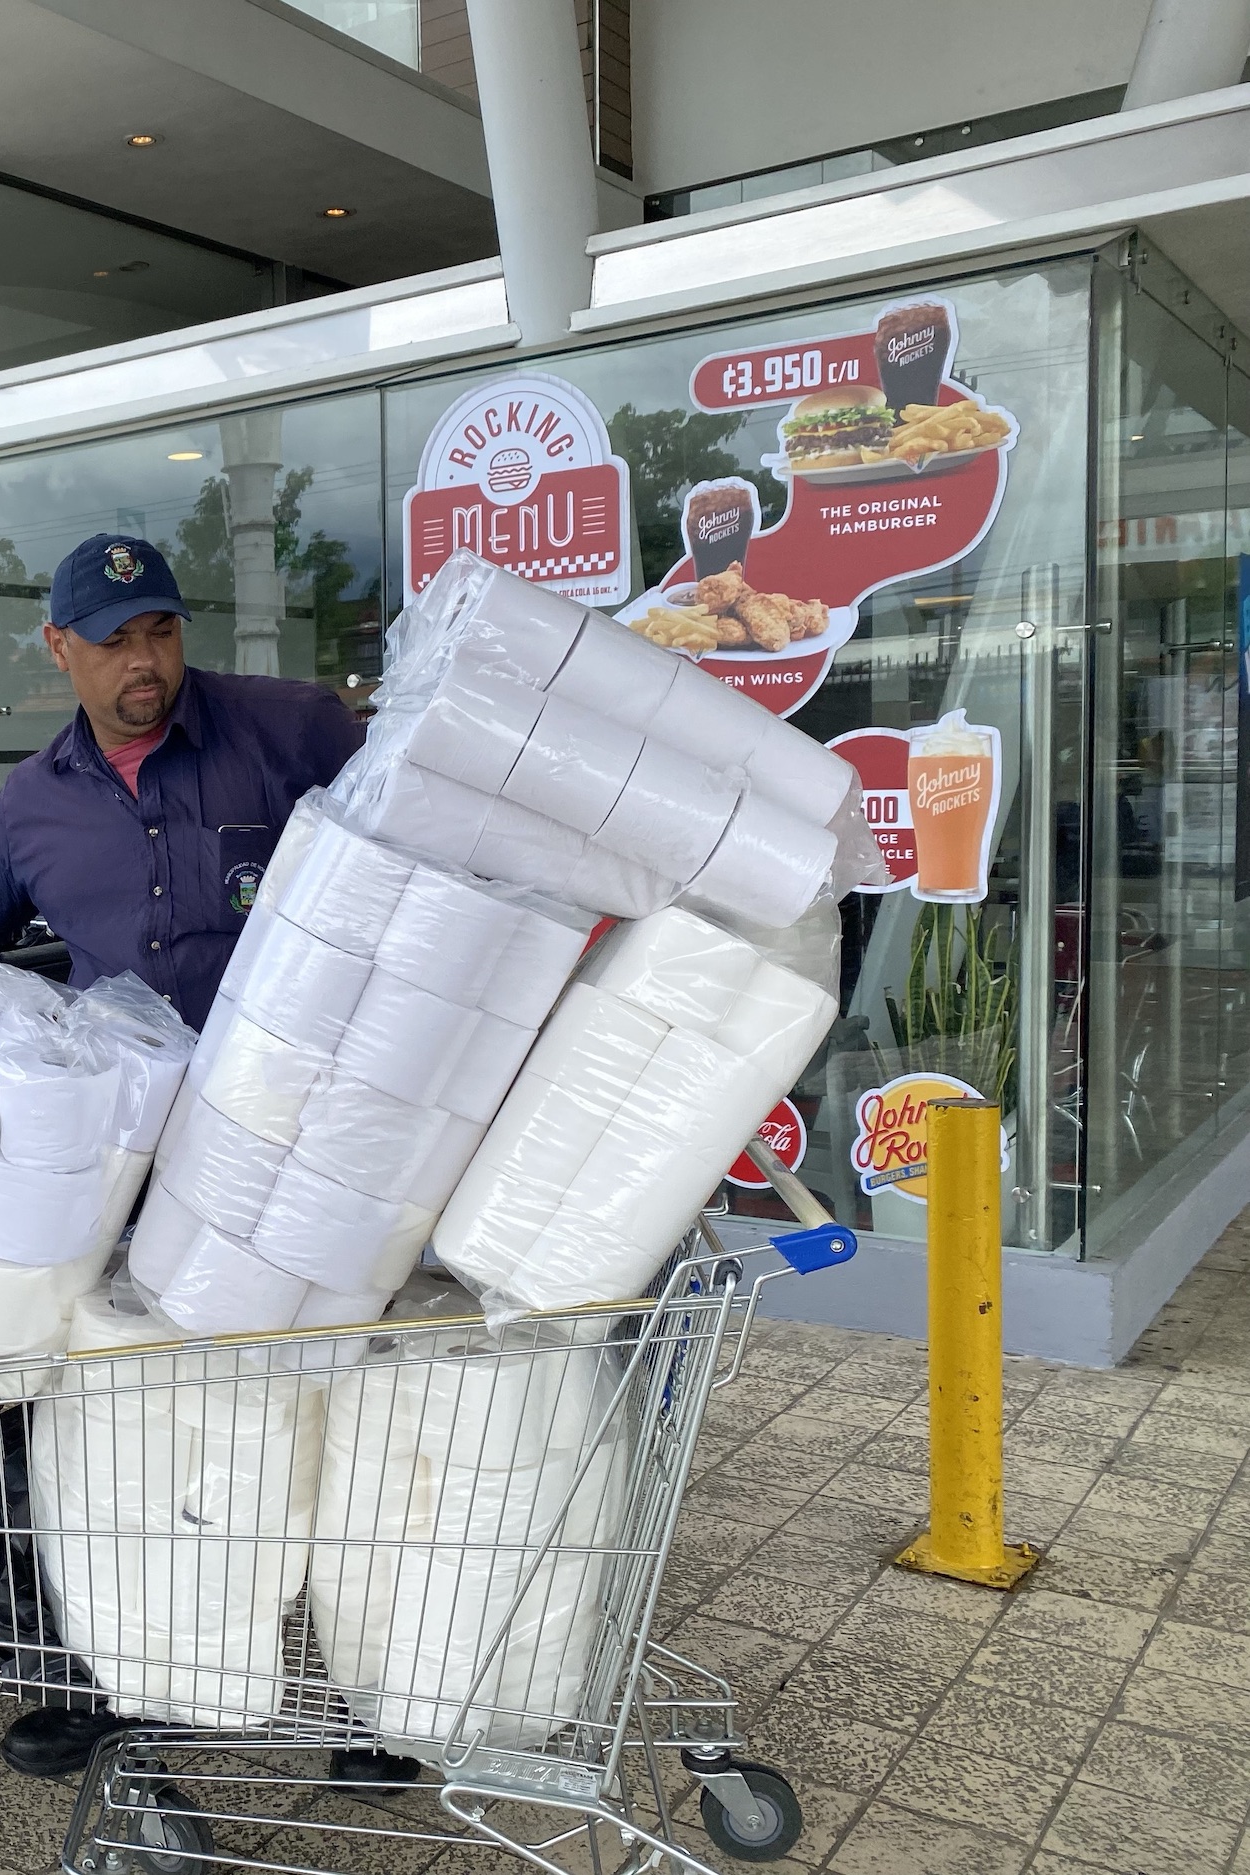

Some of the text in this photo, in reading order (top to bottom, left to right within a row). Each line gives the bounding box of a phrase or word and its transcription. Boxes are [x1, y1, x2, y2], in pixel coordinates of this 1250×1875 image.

[888, 325, 935, 363] Johnny
[899, 343, 934, 367] ROCKETS
[828, 359, 859, 384] C/U
[449, 401, 574, 469] ROCKING
[820, 495, 942, 519] THE ORIGINAL
[452, 491, 574, 557] MENU
[699, 506, 740, 540] Johnny
[709, 523, 740, 544] ROCKETS
[830, 513, 937, 535] HAMBURGER
[750, 672, 803, 686] WINGS
[917, 762, 981, 809] Johnny
[932, 788, 980, 816] ROCKETS
